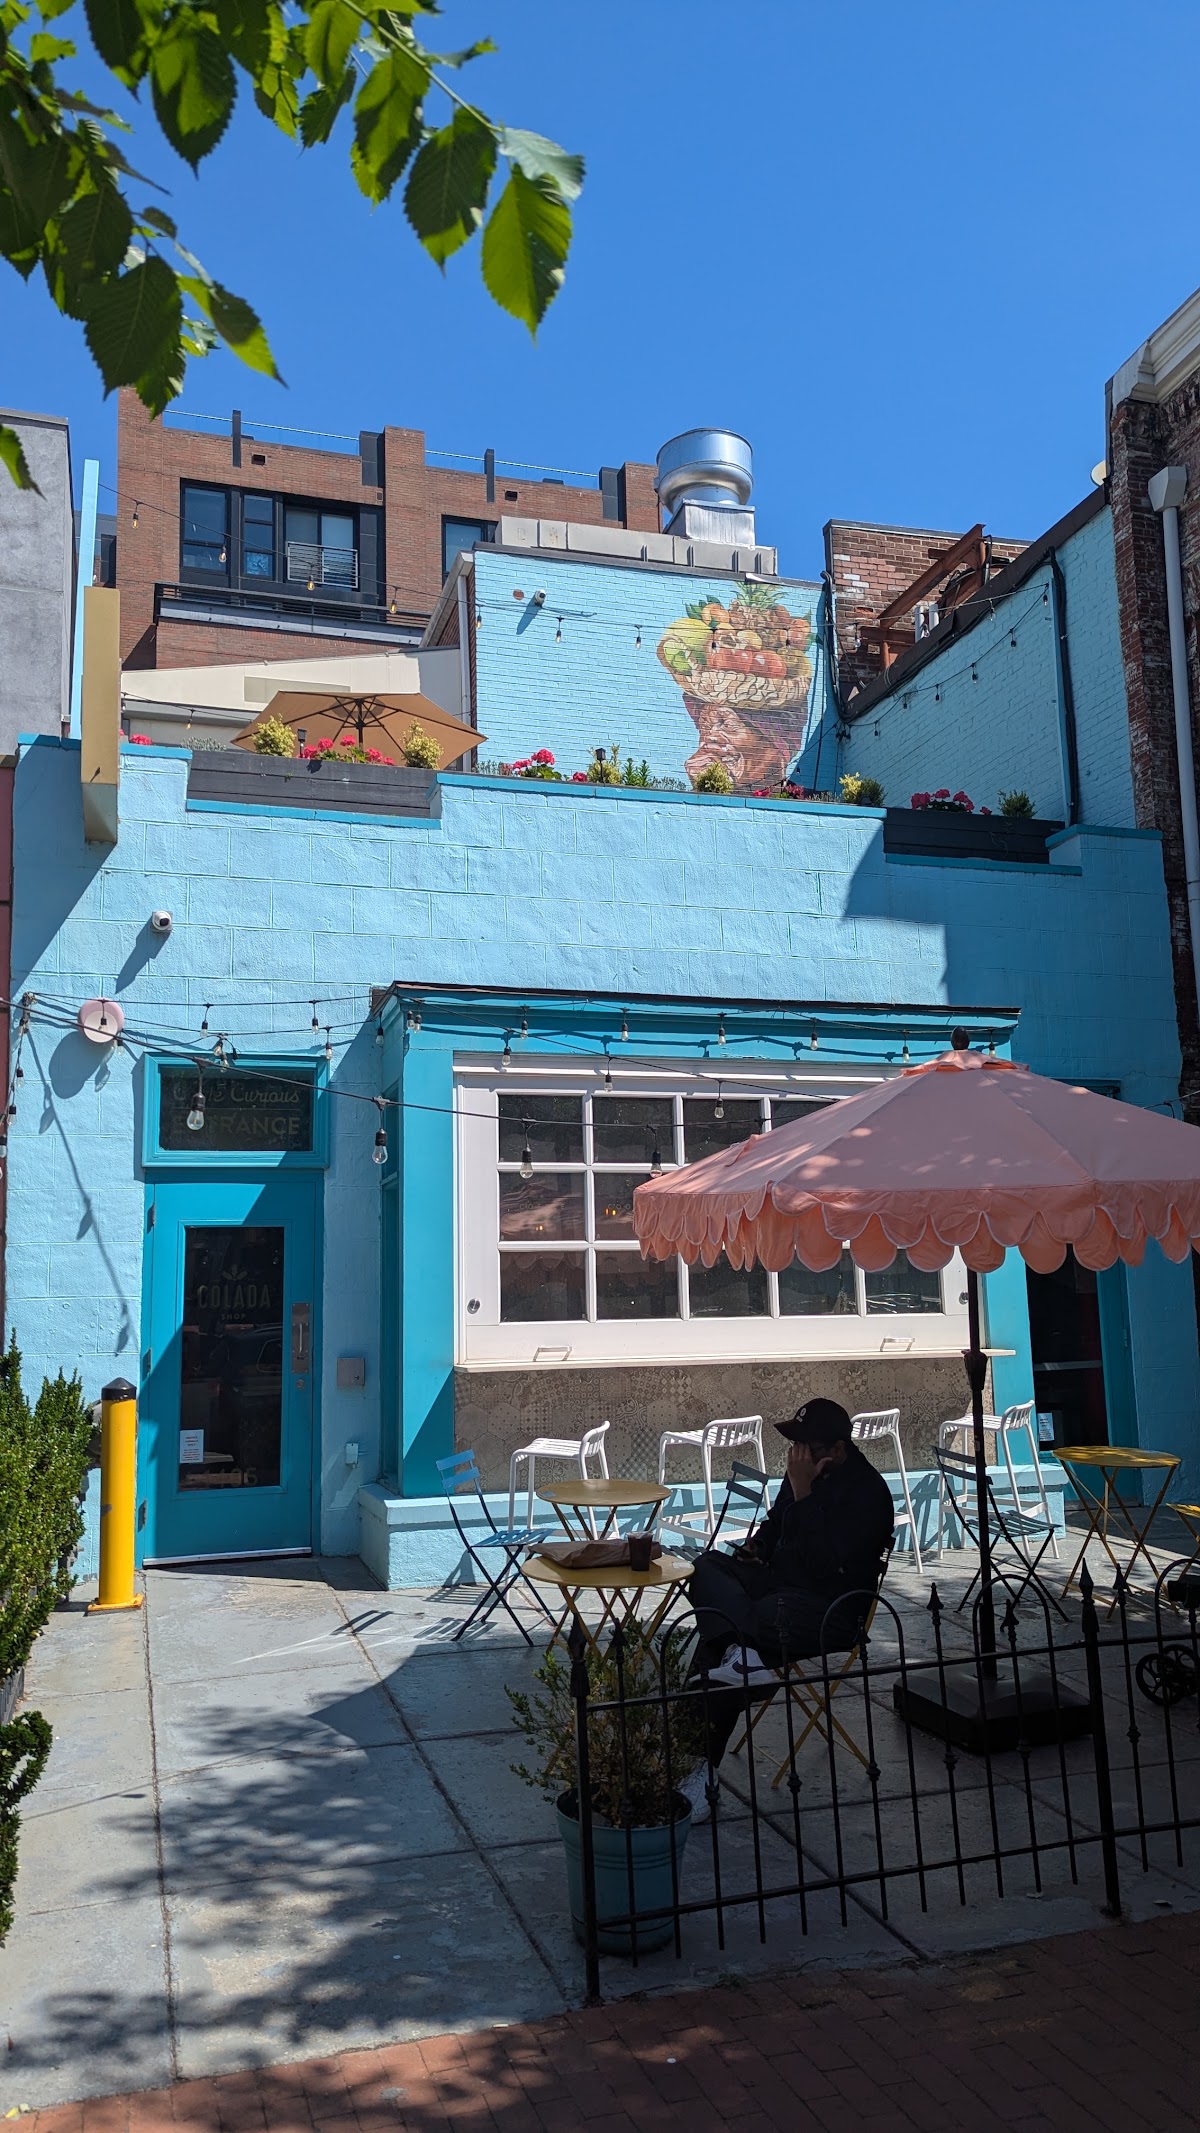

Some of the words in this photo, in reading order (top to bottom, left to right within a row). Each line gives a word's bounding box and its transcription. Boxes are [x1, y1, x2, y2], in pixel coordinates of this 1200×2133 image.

[231, 1083, 300, 1103] Curious
[172, 1116, 300, 1135] ETRANCE
[197, 1284, 271, 1309] COLADA
